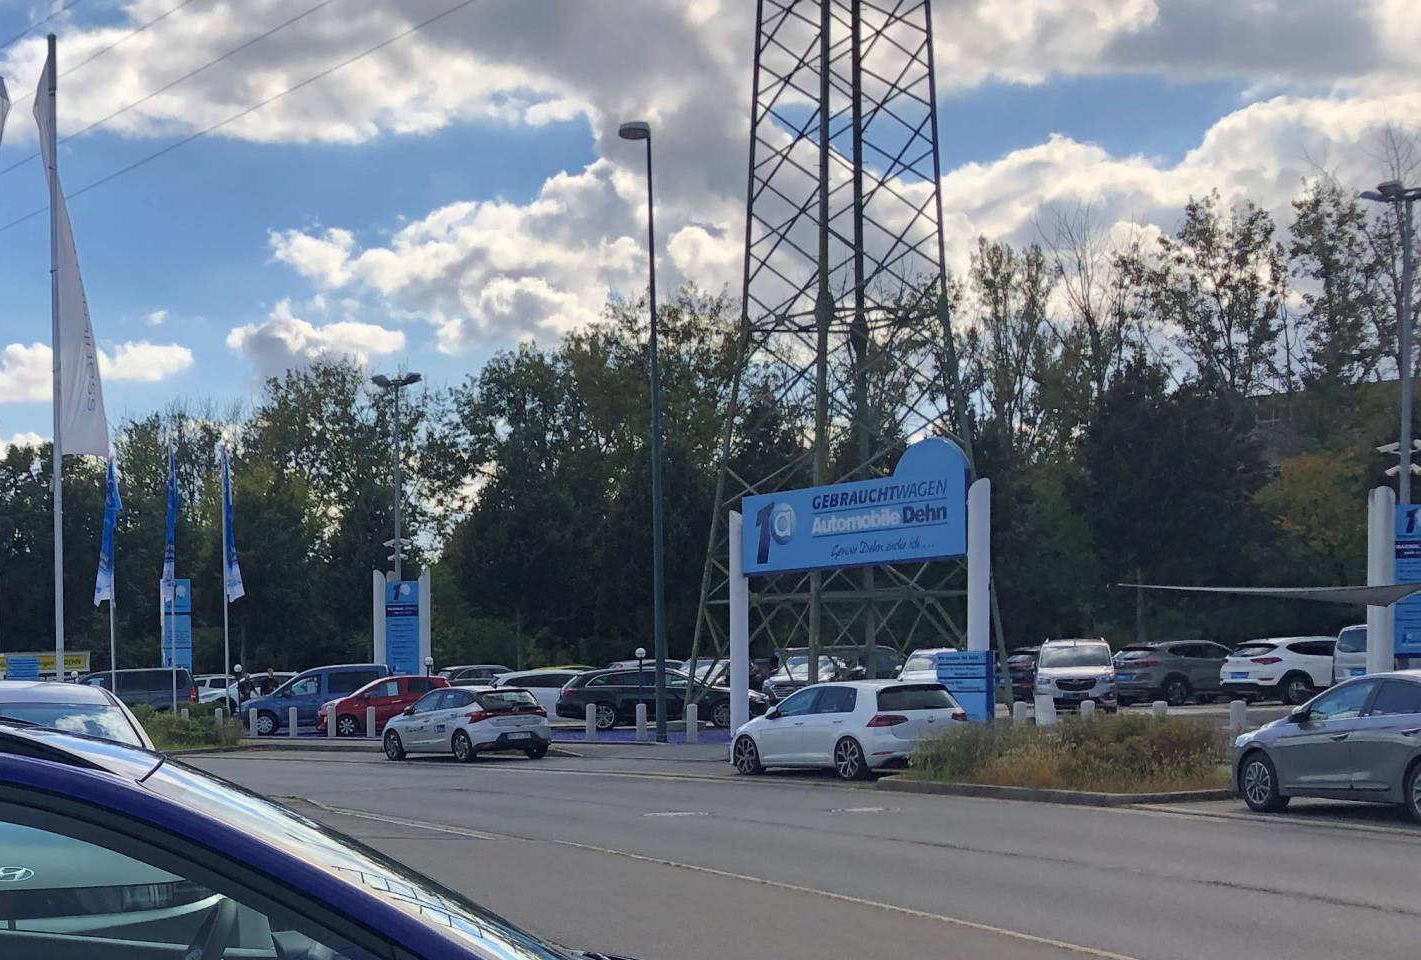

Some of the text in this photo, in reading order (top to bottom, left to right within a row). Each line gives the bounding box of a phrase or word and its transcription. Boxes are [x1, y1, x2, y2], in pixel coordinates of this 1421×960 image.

[812, 479, 948, 511] GEBRAUCHTWAGEN
[812, 503, 947, 535] Automobile Dehn
